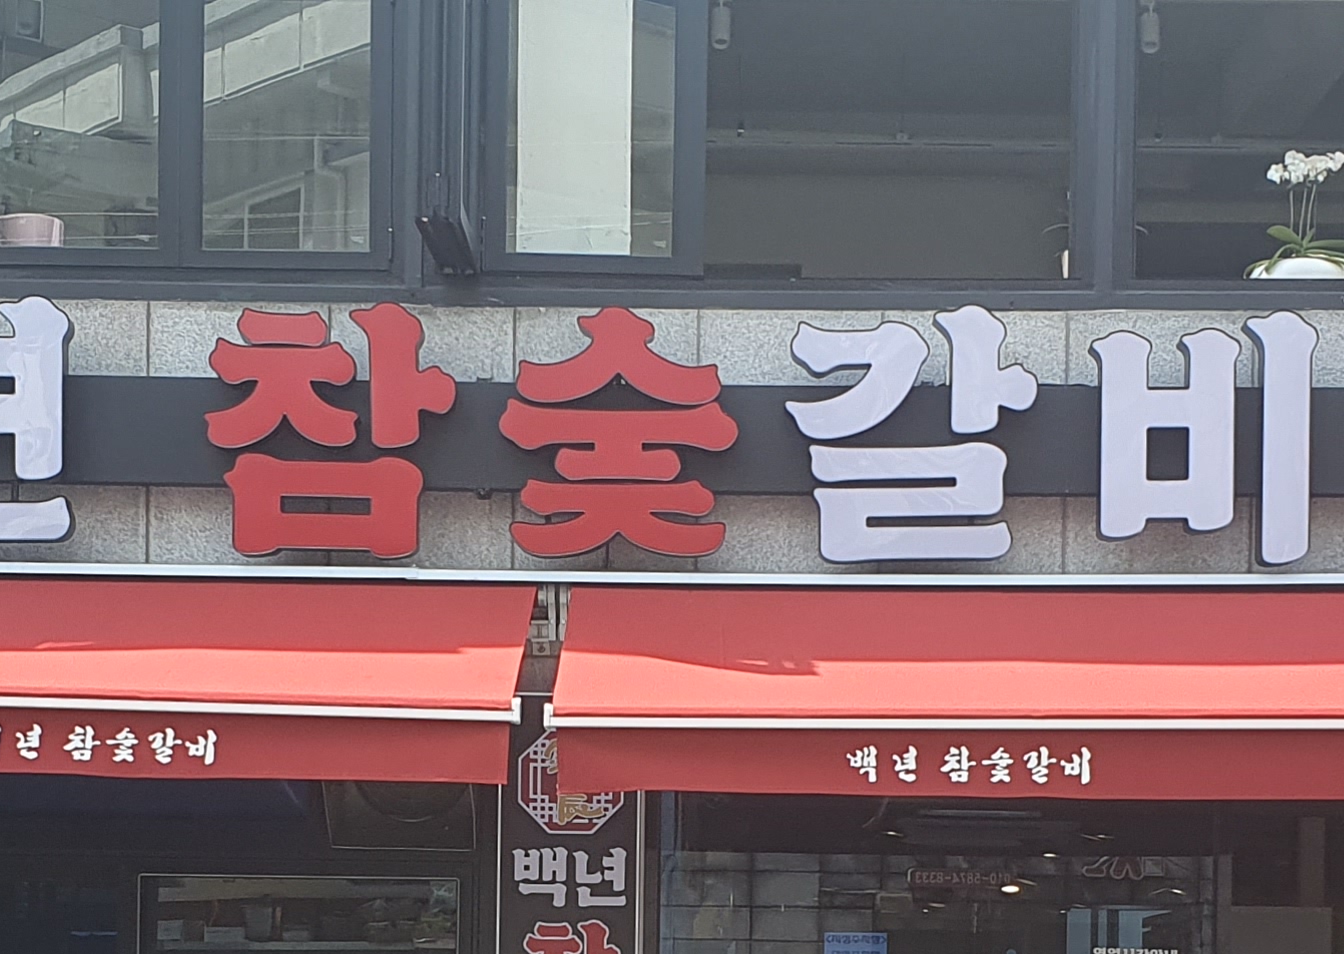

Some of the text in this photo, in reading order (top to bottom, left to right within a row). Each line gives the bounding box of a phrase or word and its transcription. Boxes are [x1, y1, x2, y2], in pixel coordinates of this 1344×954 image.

[203, 302, 1319, 567] 참숯갈비
[62, 725, 217, 766] 참숯갈비
[846, 745, 1093, 785] 백년 참숯갈비
[511, 846, 628, 908] 백년
